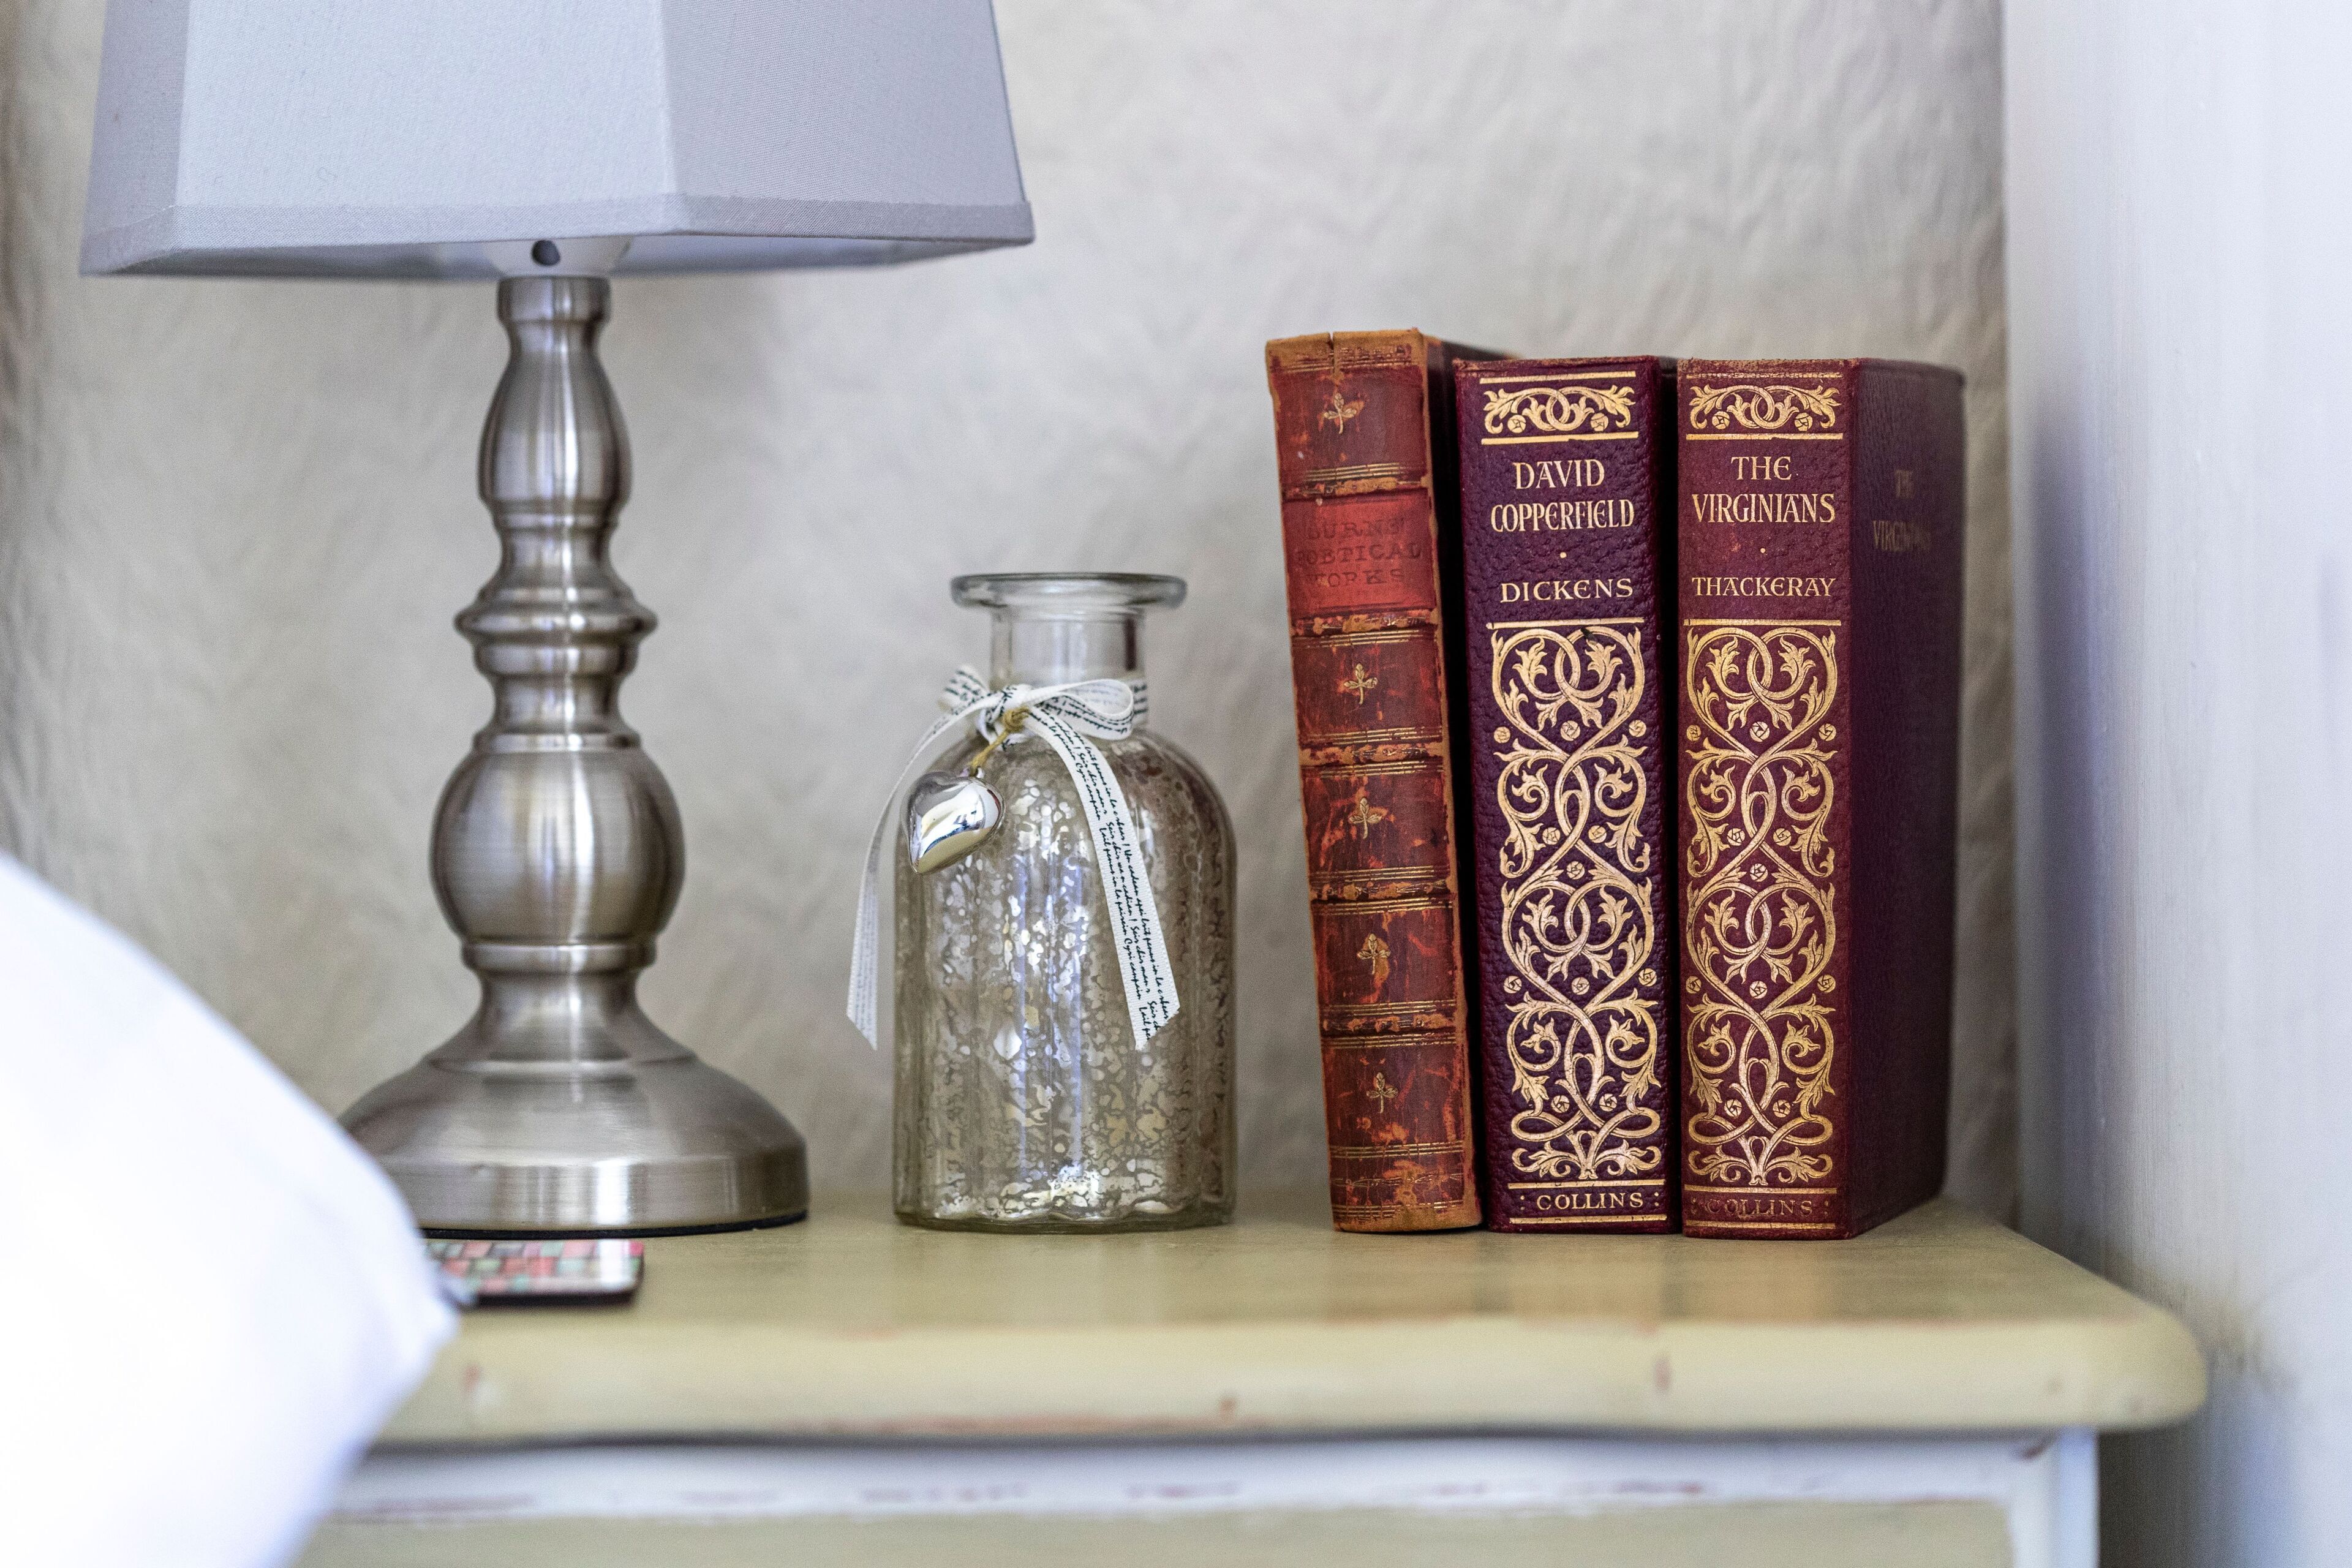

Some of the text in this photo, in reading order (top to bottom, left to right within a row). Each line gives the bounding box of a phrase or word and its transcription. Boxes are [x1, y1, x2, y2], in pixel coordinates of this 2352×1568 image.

[1512, 459, 1605, 489] DAVID
[1730, 456, 1792, 480] THE
[1490, 499, 1635, 532] COPPERFIELD
[1692, 493, 1836, 523] VIRGINIANS
[1500, 578, 1634, 603] DICKENS
[1692, 576, 1836, 597] THACKERAY
[1536, 1191, 1645, 1211] COLLINS
[1705, 1198, 1813, 1216] COLLINS
